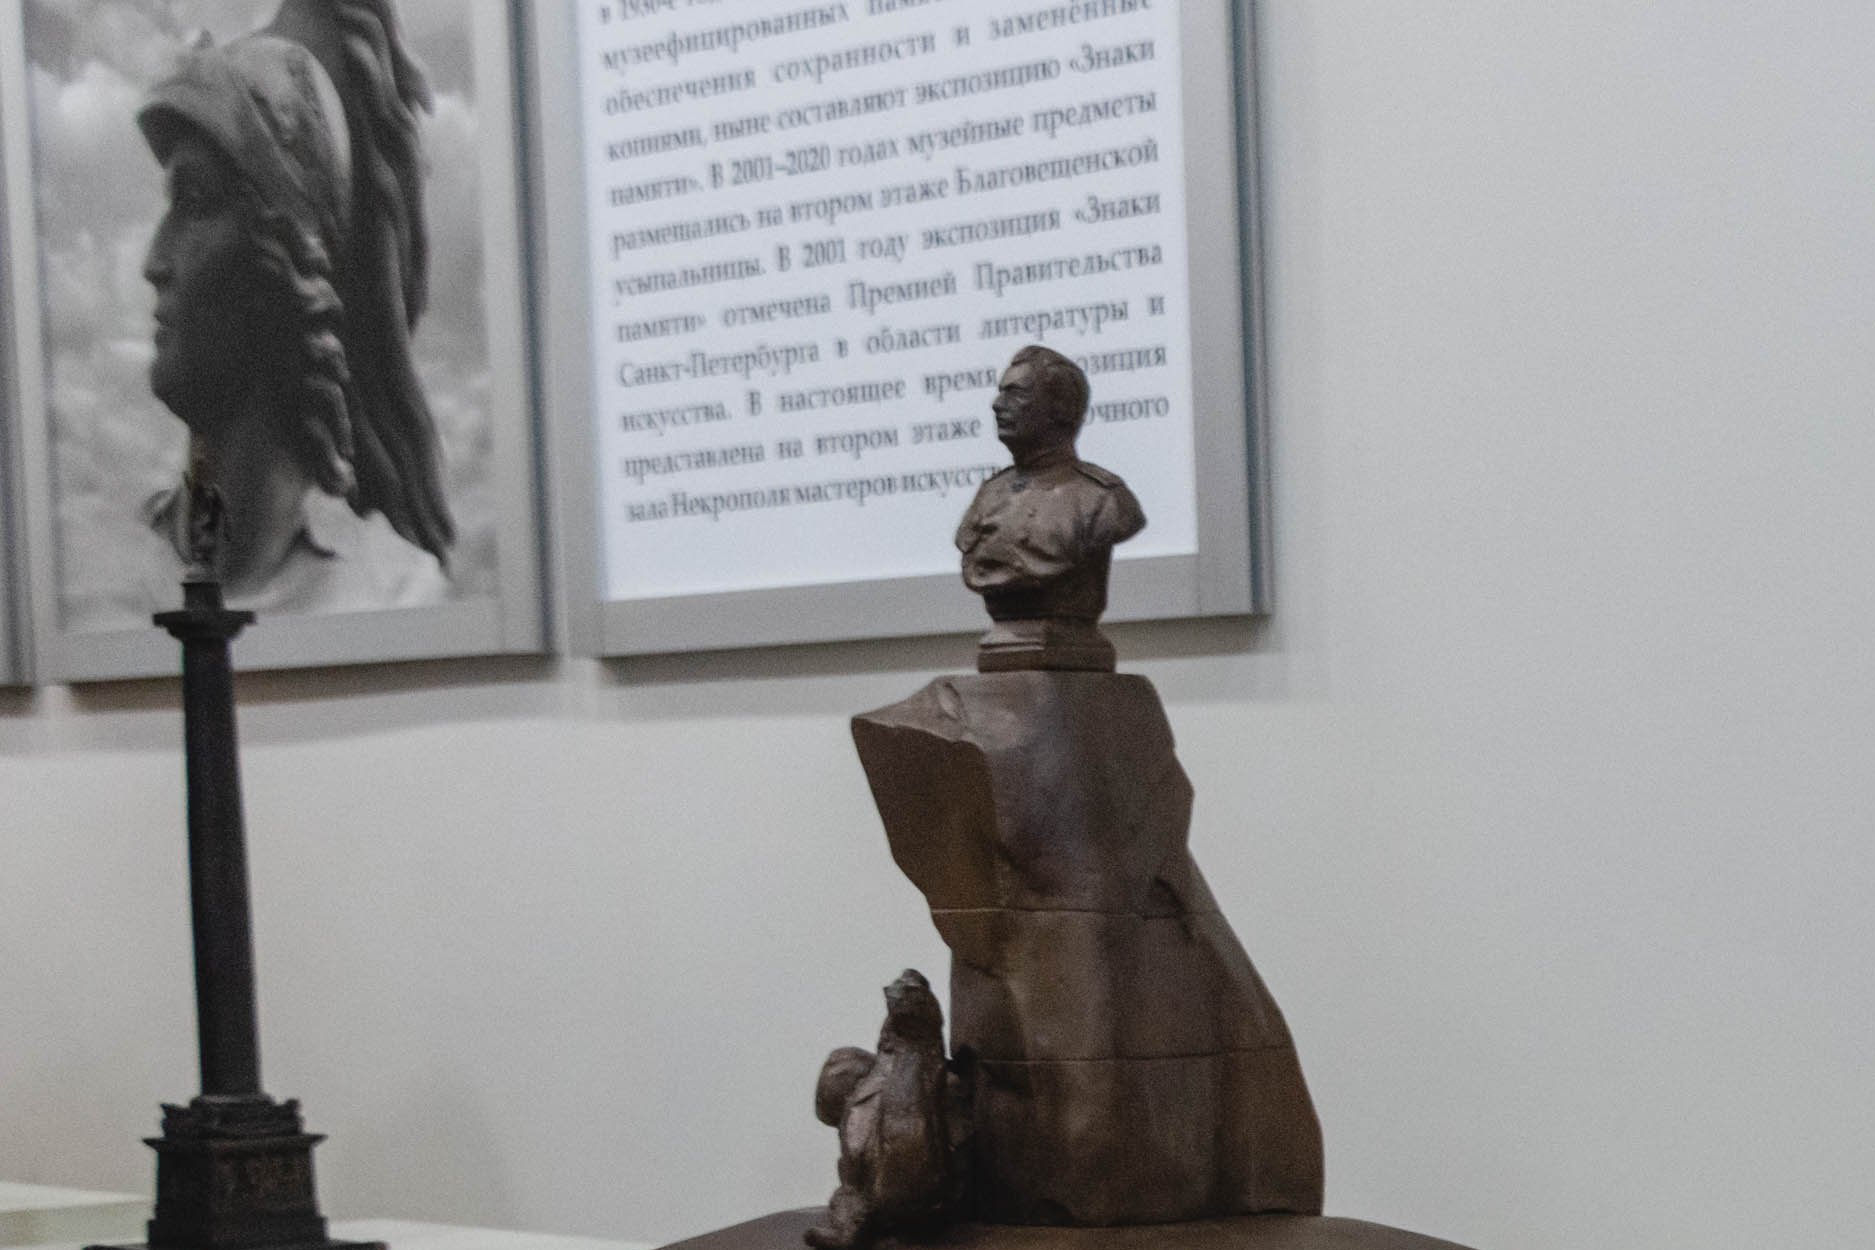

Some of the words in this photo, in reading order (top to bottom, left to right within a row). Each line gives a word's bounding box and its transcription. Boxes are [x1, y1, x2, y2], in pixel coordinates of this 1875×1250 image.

[605, 69, 756, 117] обеспечения
[773, 33, 936, 84] сохранности
[953, 25, 971, 47] и
[608, 128, 707, 161] копиями,
[713, 115, 771, 142] ныне
[777, 89, 908, 131] составляют
[915, 57, 1062, 105] экспозицию
[1069, 40, 1156, 73] «Знаки
[710, 161, 724, 189] В
[838, 137, 899, 168] годах
[908, 113, 1025, 160] музейные
[1033, 91, 1158, 138] предметы
[613, 213, 751, 261] размещались
[757, 207, 784, 229] на
[791, 191, 873, 226] втором
[881, 178, 949, 208] этаже
[956, 137, 1160, 196] Благовещенской
[615, 257, 766, 307] усыпальницы.
[776, 243, 792, 272] В
[803, 238, 847, 269] 2001
[859, 233, 909, 263] году
[922, 209, 1061, 250] экспозиция
[1074, 193, 1161, 225] «Знаки
[723, 293, 832, 328] отмечена
[849, 270, 957, 315] Премией
[974, 244, 1164, 297] Правительства
[618, 343, 820, 387] Санкт-Петербурга
[836, 336, 849, 359] в
[866, 322, 961, 354] области
[979, 301, 1129, 341] литературы
[1148, 295, 1165, 317] и
[748, 389, 763, 417] В
[779, 379, 907, 413] настоящее
[924, 367, 998, 401] время
[624, 443, 766, 485] представлена
[777, 438, 803, 460] на
[816, 428, 899, 460] втором
[911, 417, 981, 445] этаже
[626, 500, 669, 523] зала
[671, 485, 791, 522] Некрополя
[795, 474, 898, 507] мастеров
